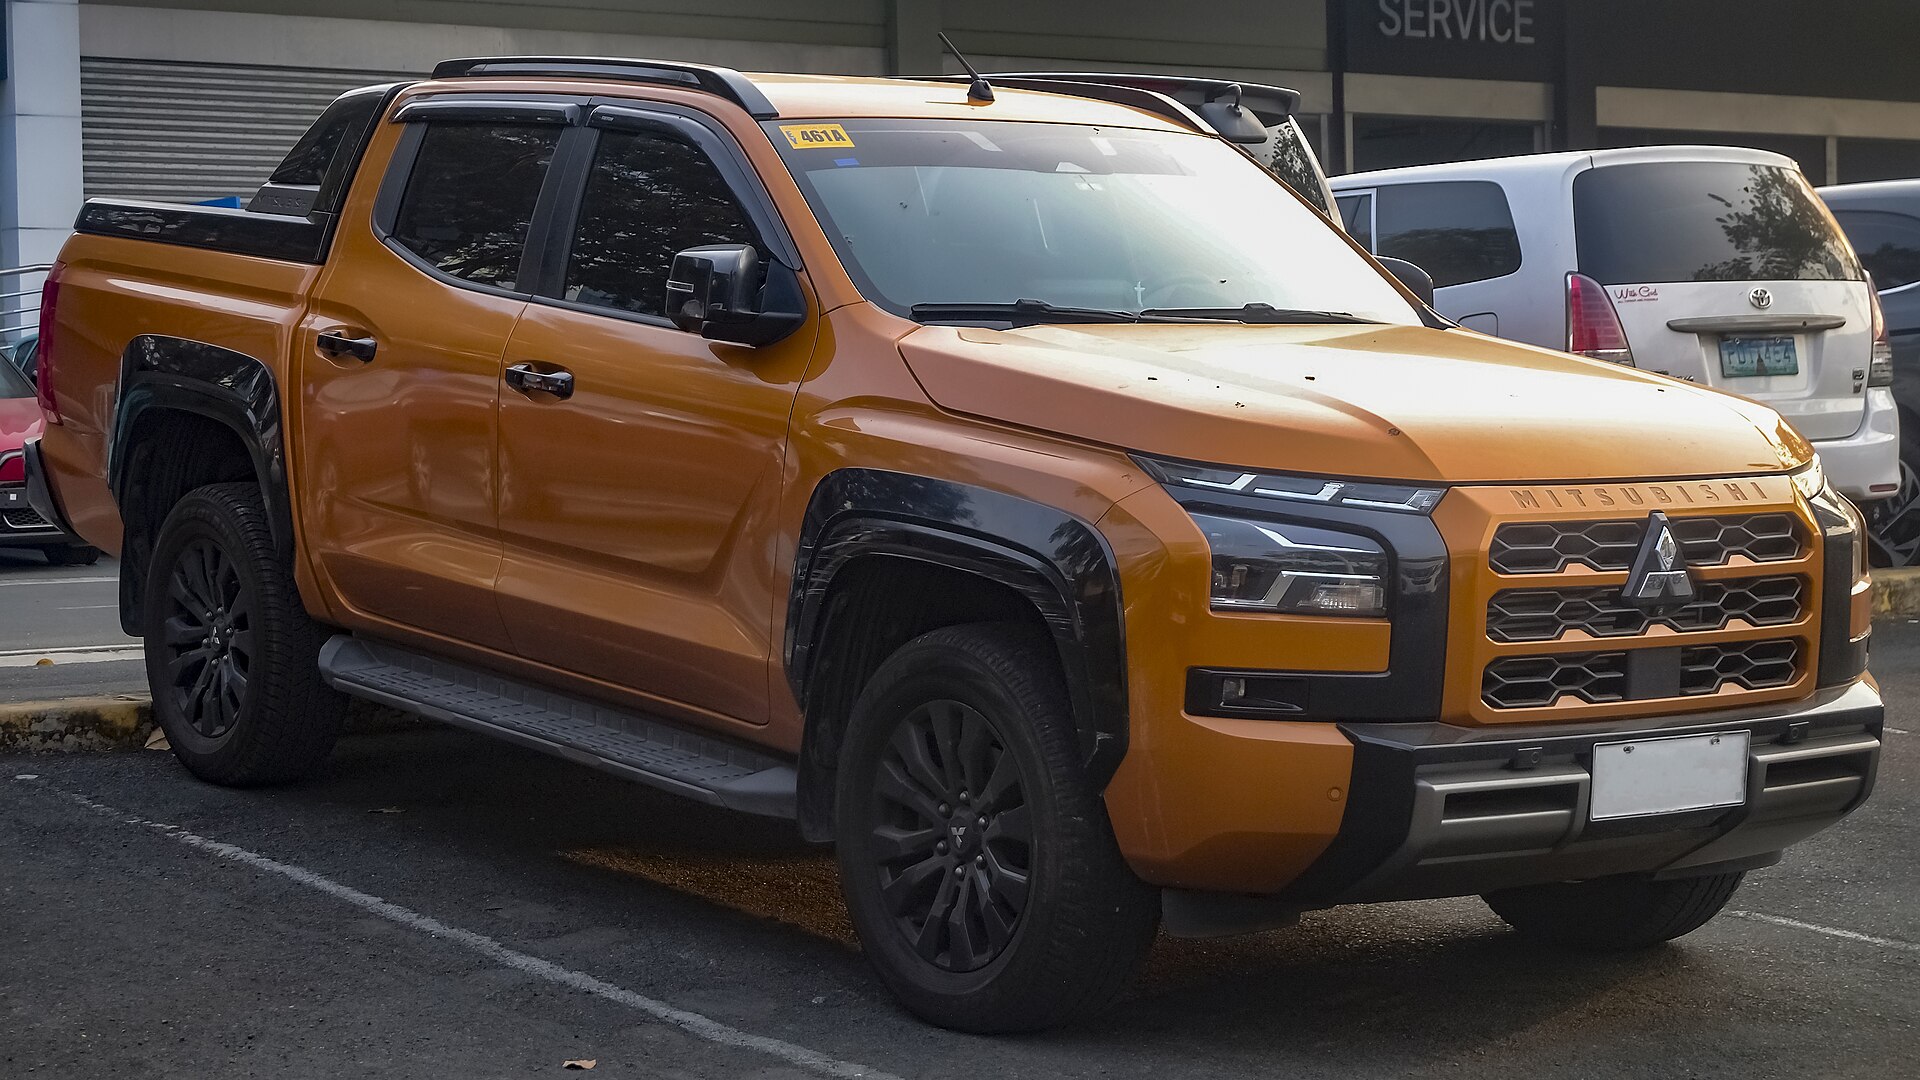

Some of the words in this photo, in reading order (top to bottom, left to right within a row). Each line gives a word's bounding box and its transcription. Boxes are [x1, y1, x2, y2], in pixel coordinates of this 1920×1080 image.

[1378, 0, 1535, 44] SERVICE
[800, 129, 847, 143] 461A
[1510, 481, 1768, 509] MITSUBISHI
